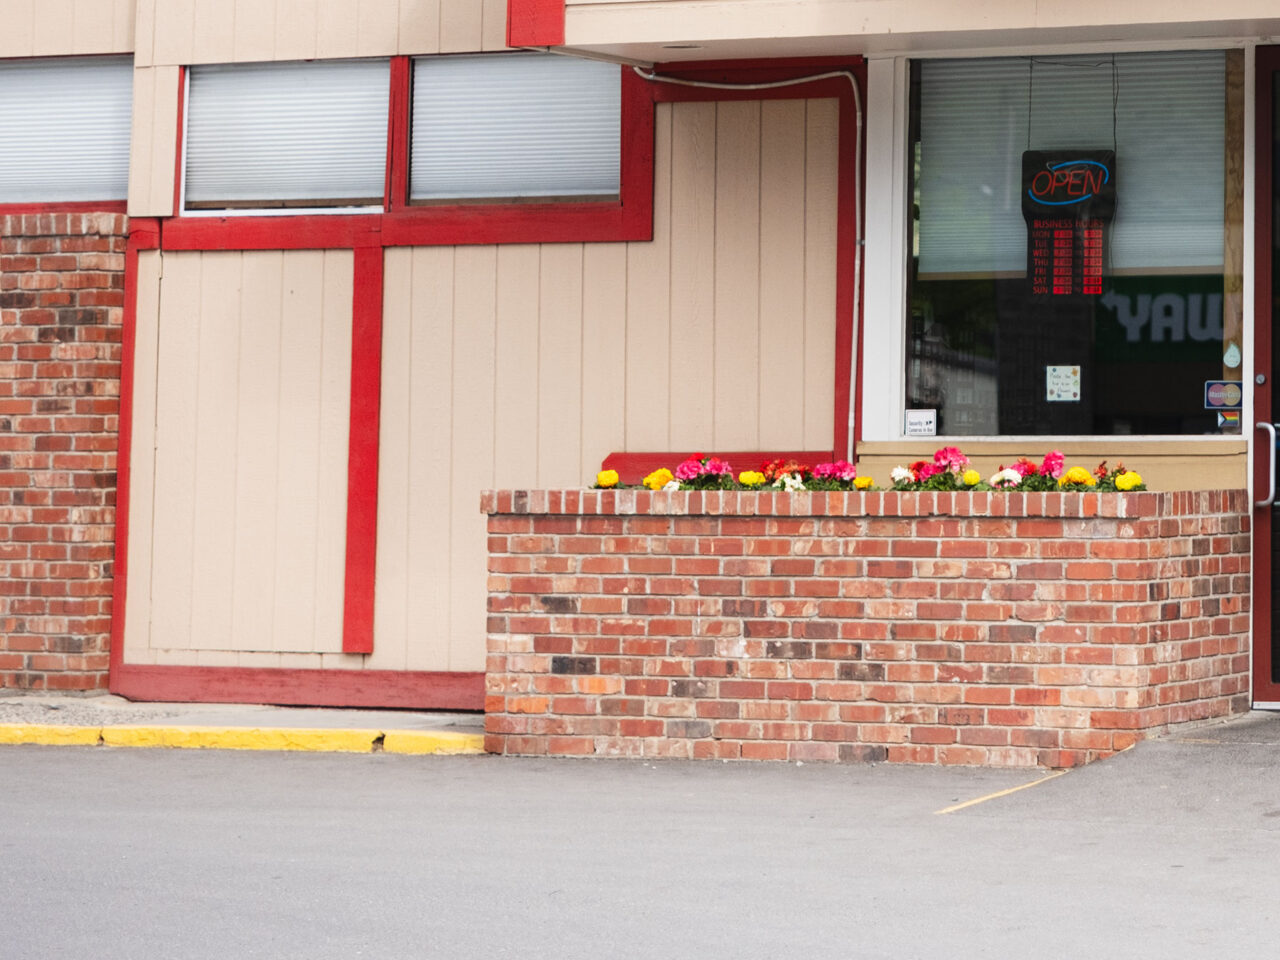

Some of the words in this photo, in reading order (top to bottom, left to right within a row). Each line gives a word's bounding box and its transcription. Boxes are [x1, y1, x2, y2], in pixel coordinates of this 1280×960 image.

[1032, 170, 1104, 196] OPEN
[1033, 219, 1073, 229] BUSINESS
[1033, 276, 1047, 285] SAT
[1033, 286, 1049, 295] SUN
